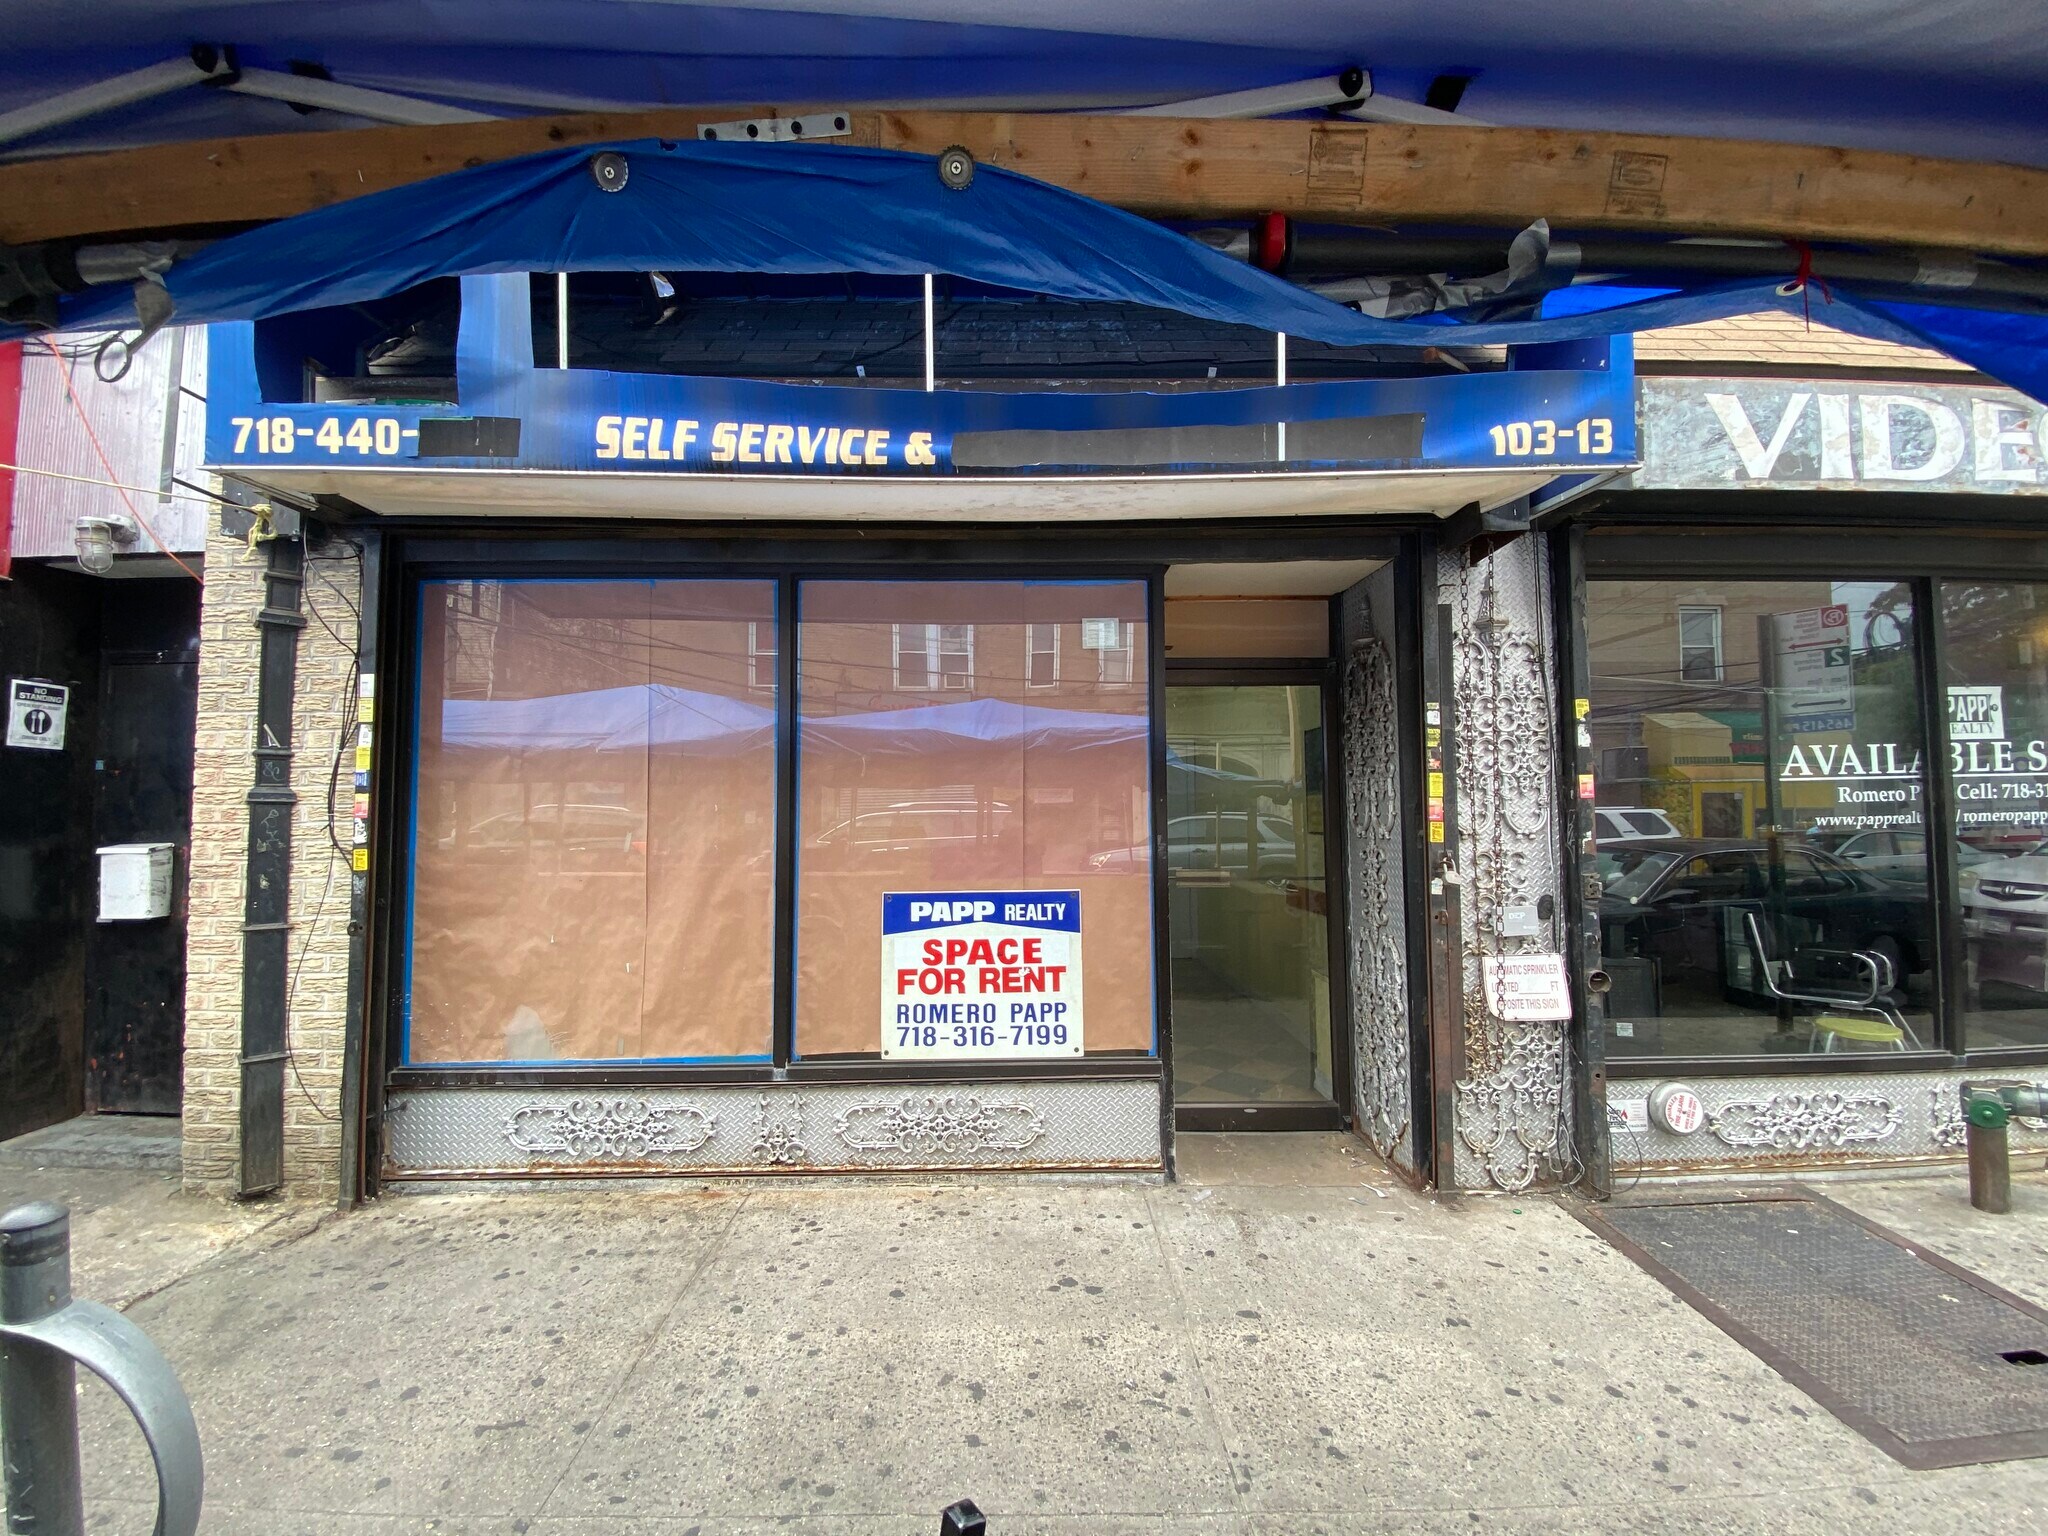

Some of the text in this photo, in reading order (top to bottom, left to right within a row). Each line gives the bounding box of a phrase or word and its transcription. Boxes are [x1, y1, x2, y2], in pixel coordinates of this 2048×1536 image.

[231, 417, 419, 455] 718-440-
[595, 415, 936, 466] SELF SERVICE &
[1489, 418, 1613, 456] 103-13
[1704, 392, 2048, 482] VIDE
[19, 692, 63, 703] STANDING
[1950, 722, 1995, 734] EALTY
[1837, 786, 1906, 804] Romero
[1956, 783, 1998, 800] Cell:
[910, 901, 1066, 922] PAPP REALTY
[922, 938, 1043, 966] SPACE
[1523, 963, 1559, 975] SPRINKLER
[897, 966, 1067, 995] FOR RENT
[1550, 980, 1559, 992] FT
[896, 1002, 1068, 1024] ROMERO PAPP
[1526, 998, 1542, 1010] THIS
[1542, 997, 1560, 1010] SIGN
[896, 1024, 1068, 1047] 718-316-7199
